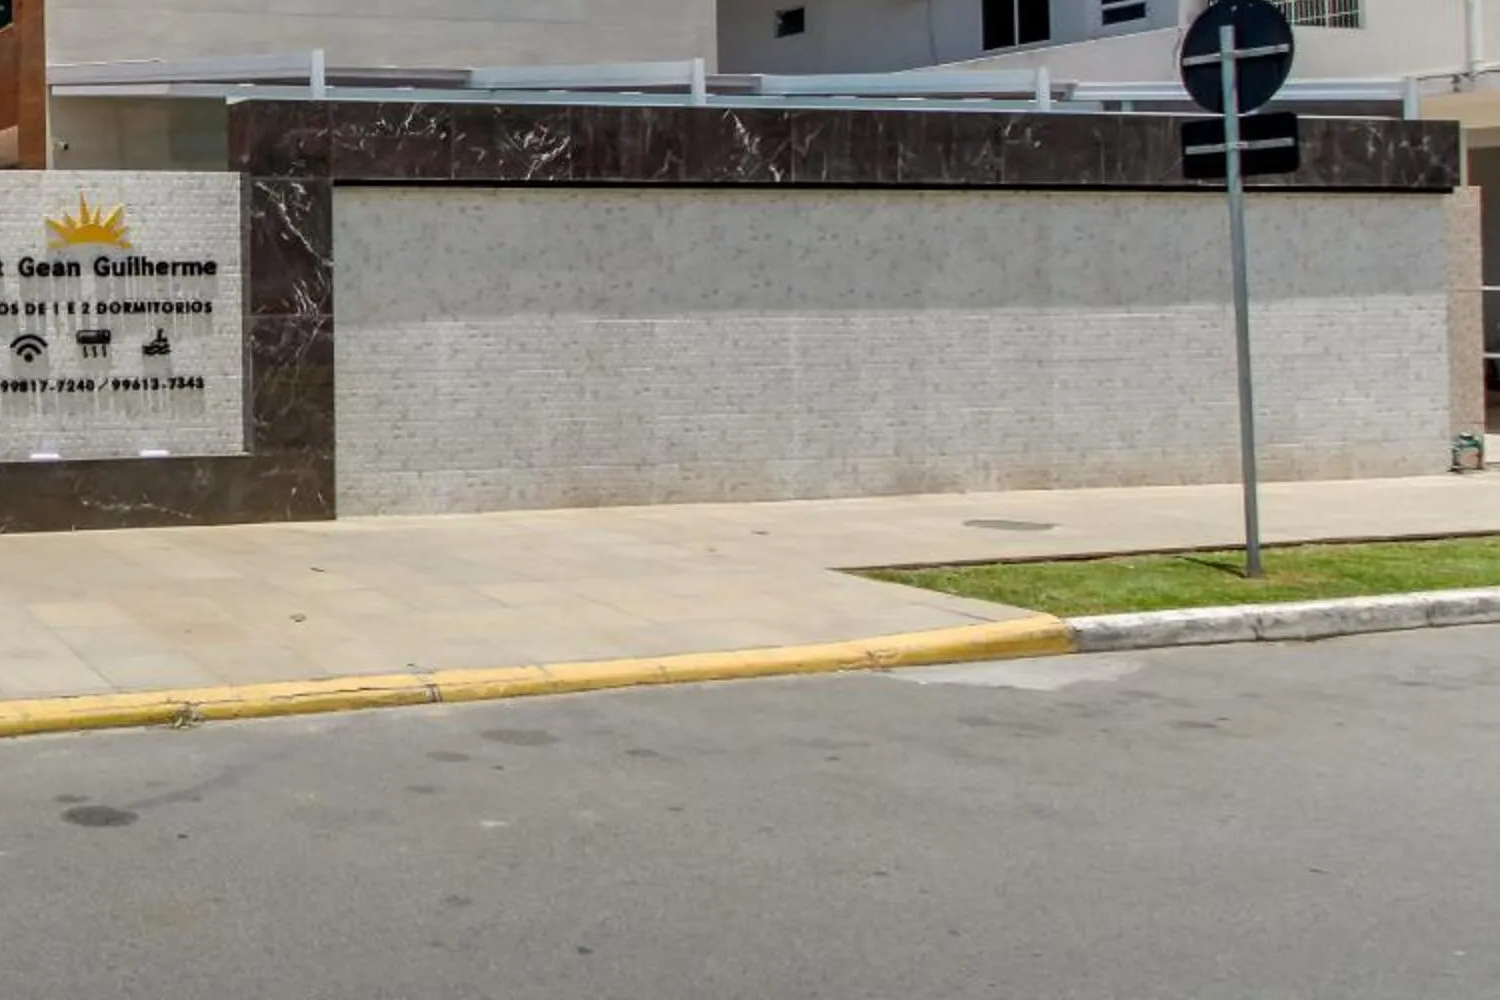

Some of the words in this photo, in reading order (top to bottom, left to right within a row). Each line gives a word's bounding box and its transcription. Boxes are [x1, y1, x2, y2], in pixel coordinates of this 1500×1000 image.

[18, 256, 82, 278] Gean
[93, 256, 217, 277] Guilherme
[25, 302, 47, 316] DE
[67, 302, 76, 315] E
[81, 302, 91, 315] 2
